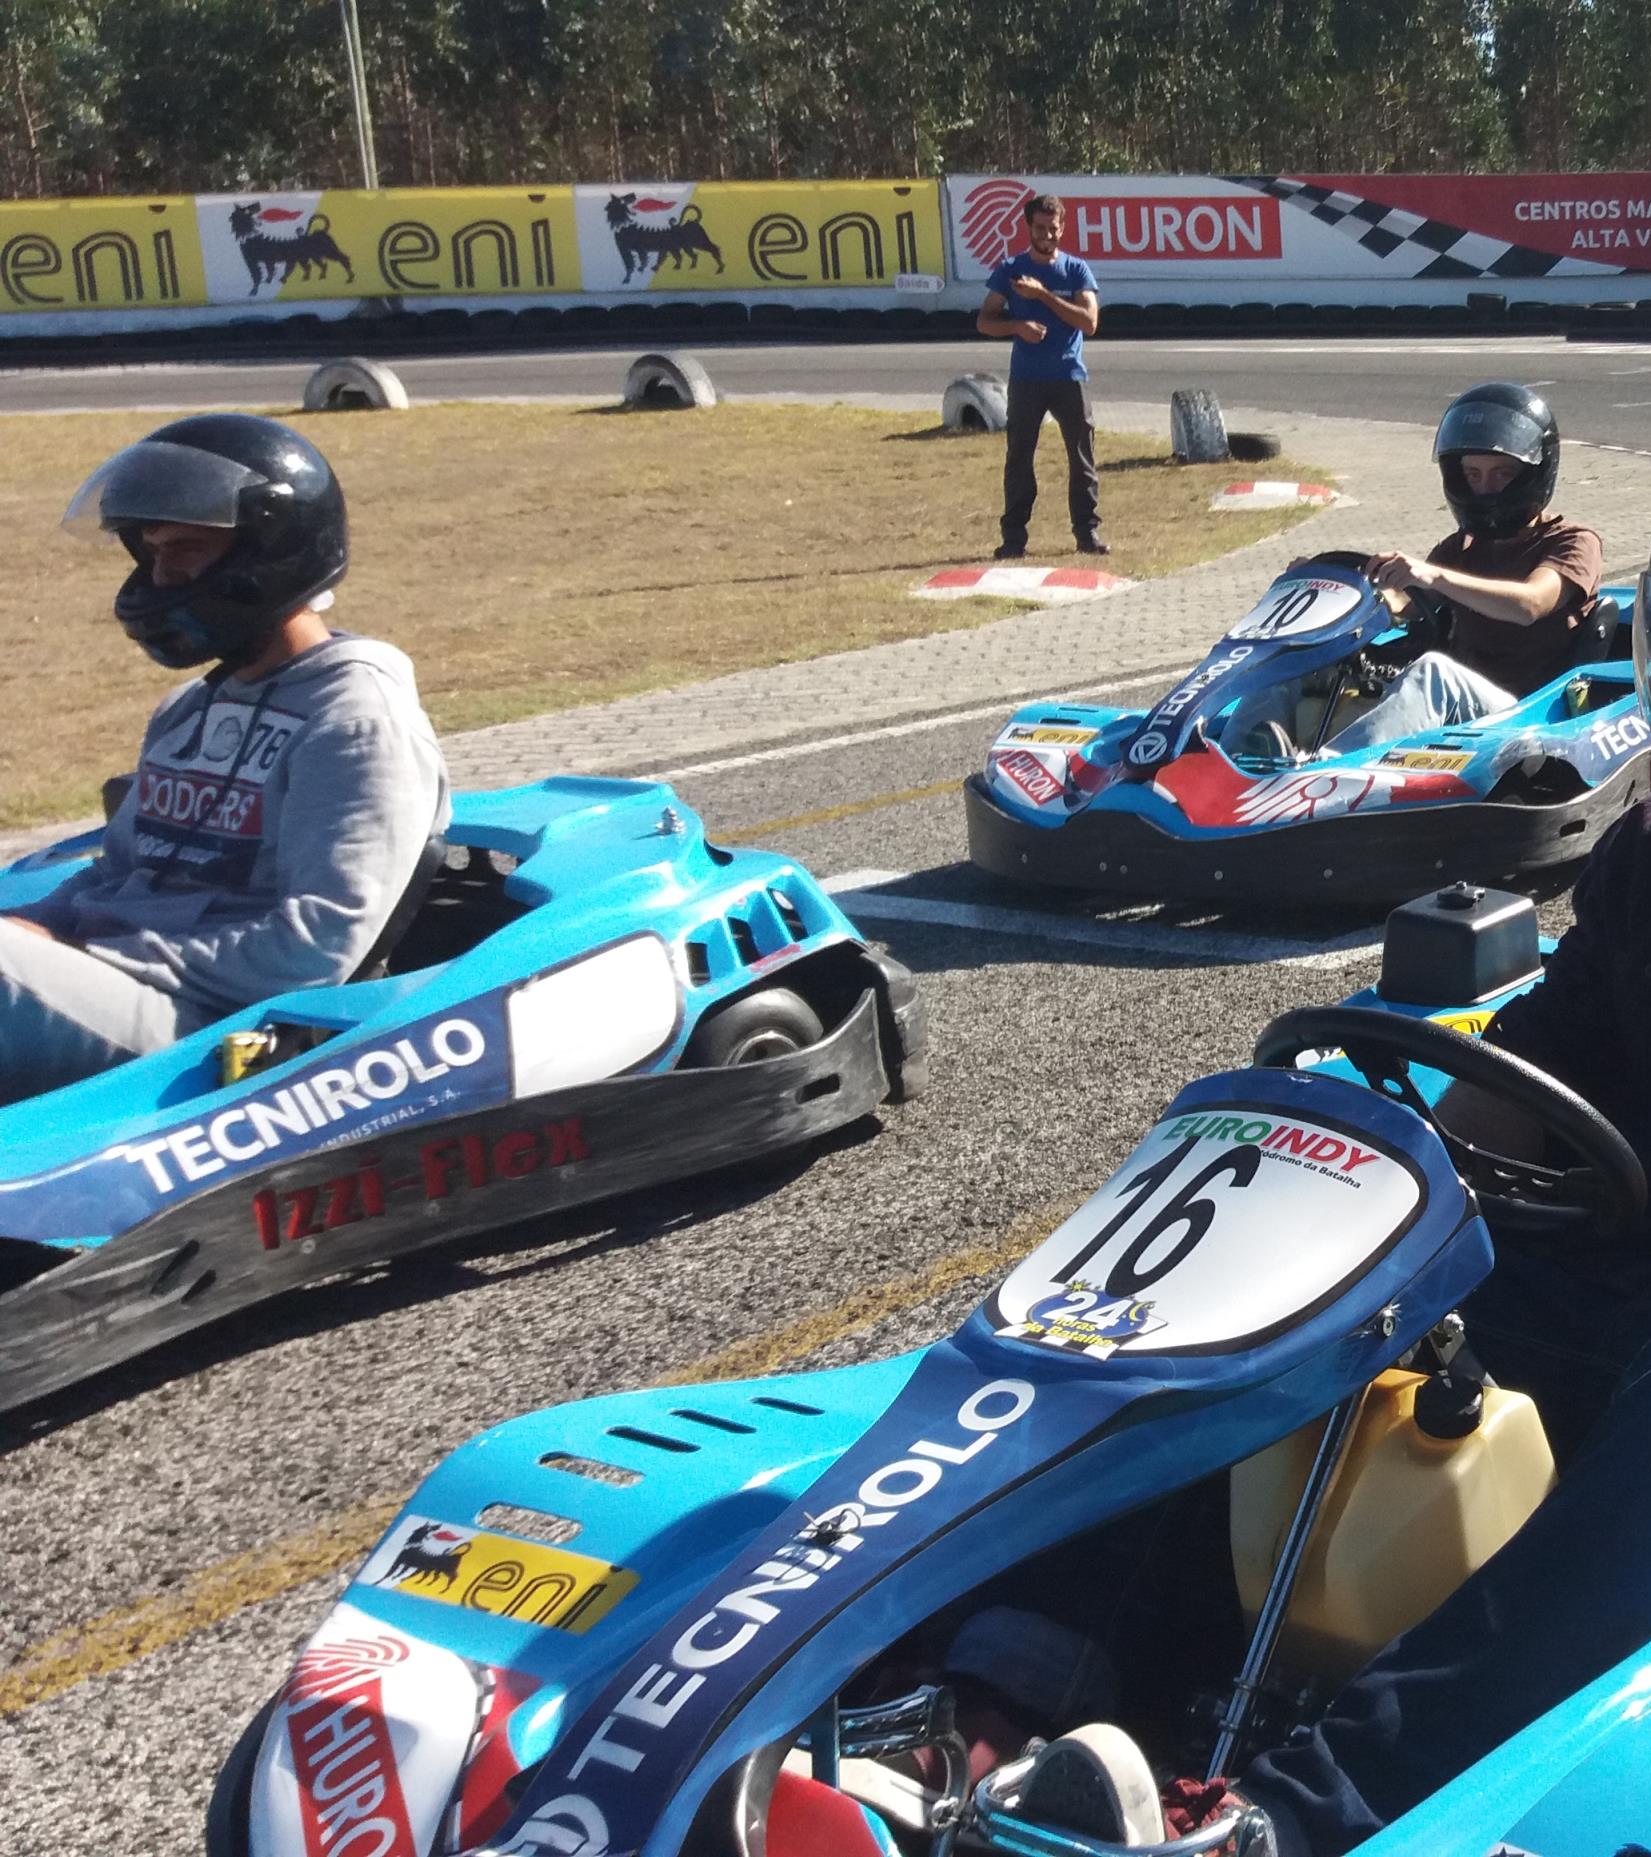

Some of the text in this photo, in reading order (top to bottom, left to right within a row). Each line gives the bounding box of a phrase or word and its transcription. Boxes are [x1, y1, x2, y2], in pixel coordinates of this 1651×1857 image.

[747, 187, 918, 281] eni
[1078, 205, 1262, 254] HURON
[1514, 199, 1621, 222] CENTROS
[0, 204, 180, 304] eni
[377, 194, 556, 290] eni
[1571, 227, 1630, 249] ALTA
[1261, 588, 1319, 630] 10
[1038, 728, 1096, 744] eni
[1010, 751, 1059, 799] HURON
[126, 1019, 485, 1194] TECNIROLO
[1162, 1116, 1381, 1173] EUROINDY
[254, 1118, 591, 1250] Izzi-Flex
[1303, 1161, 1318, 1172] da
[1319, 1166, 1362, 1189] Batalha
[1050, 1136, 1262, 1298] 16
[1022, 1321, 1115, 1347] da Batalha
[1041, 1290, 1134, 1330] 24
[1053, 1316, 1098, 1332] horas
[461, 1559, 626, 1631] eni
[567, 1378, 1036, 1782] TECNIROLO
